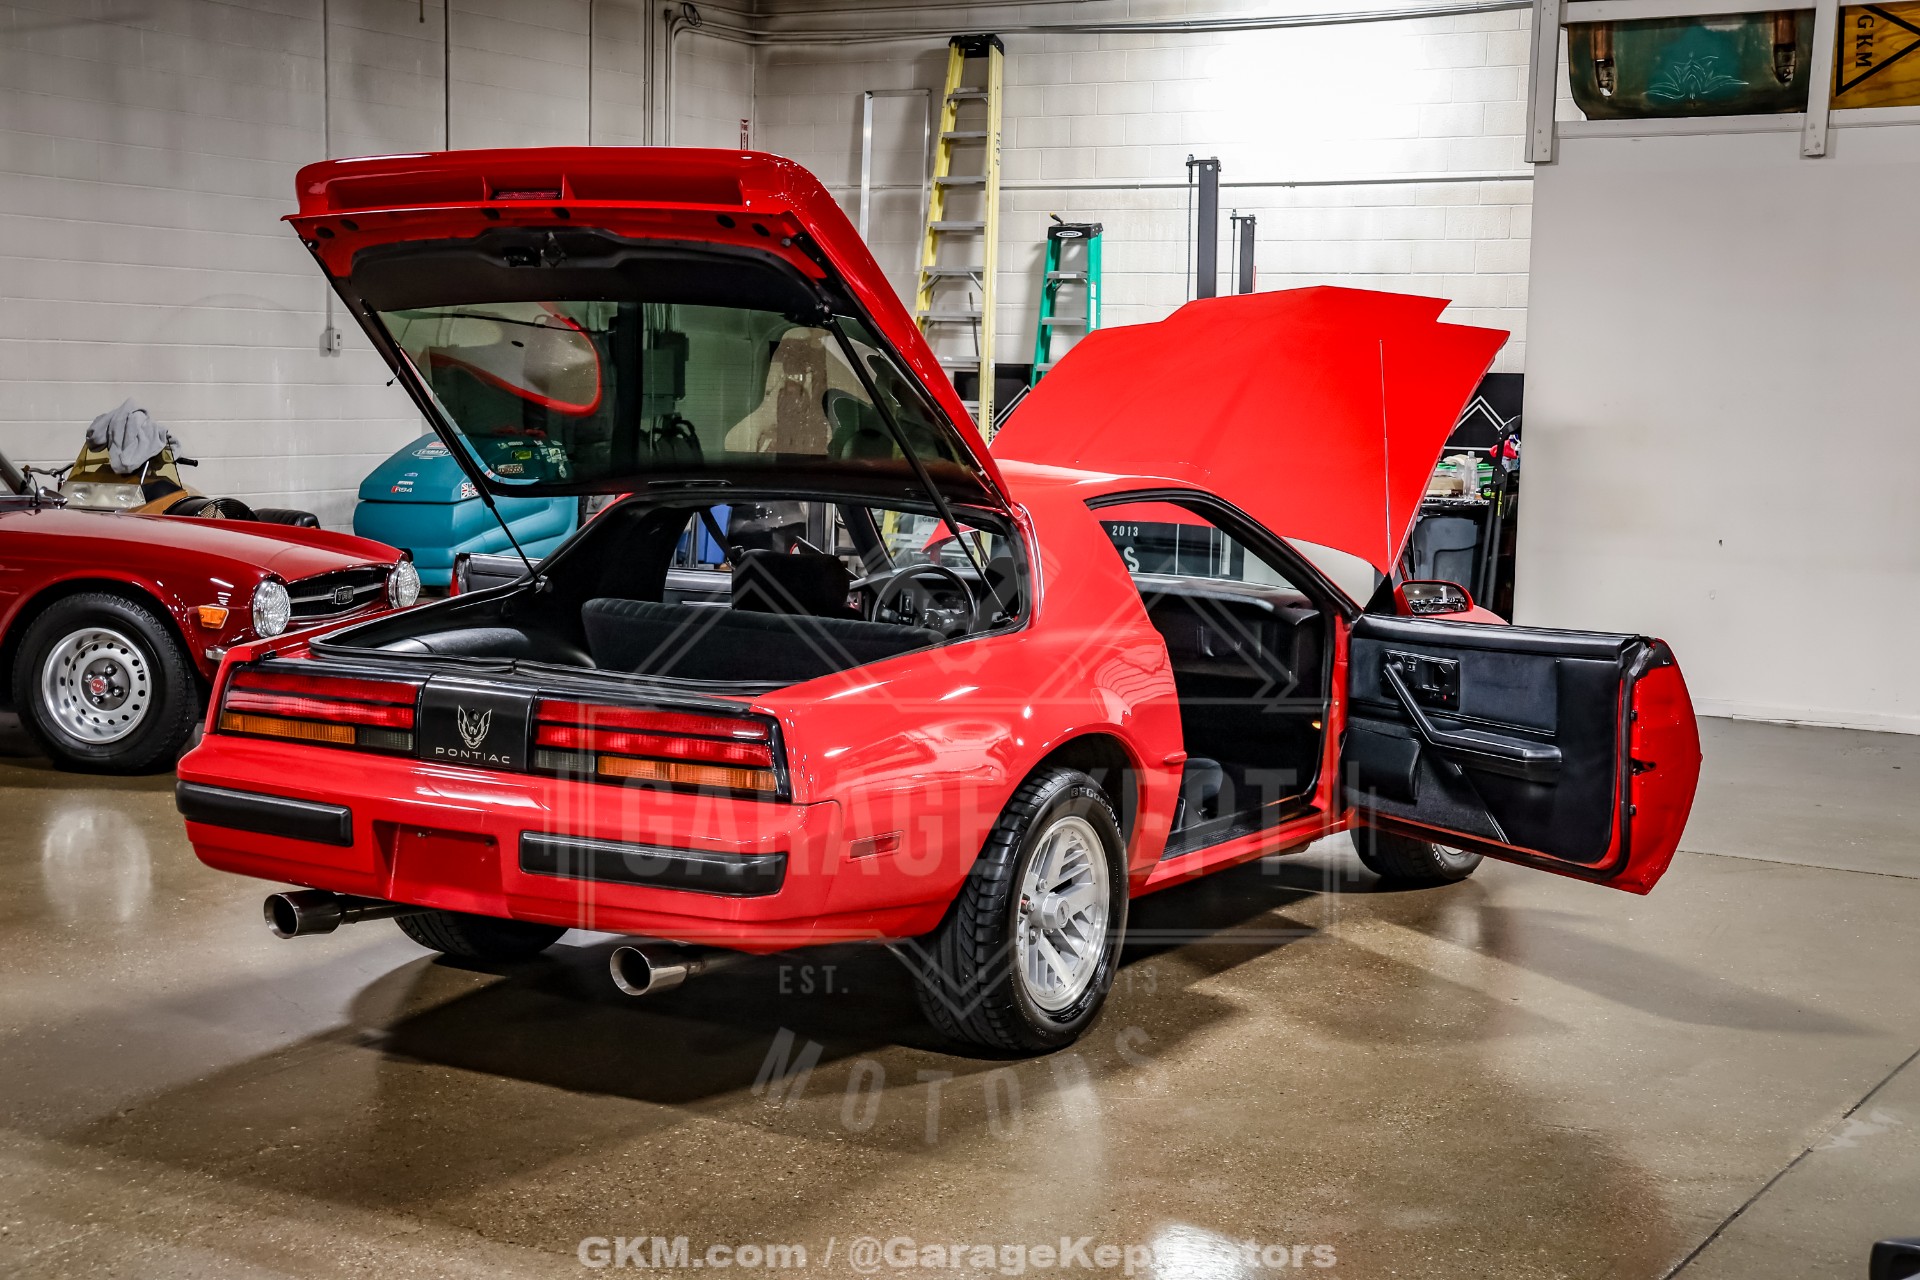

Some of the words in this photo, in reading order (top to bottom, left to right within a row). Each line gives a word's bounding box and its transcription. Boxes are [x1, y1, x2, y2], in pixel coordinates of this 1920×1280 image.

[1856, 14, 1875, 68] GKM
[1112, 525, 1139, 537] 2013
[435, 747, 510, 764] PONTIAC
